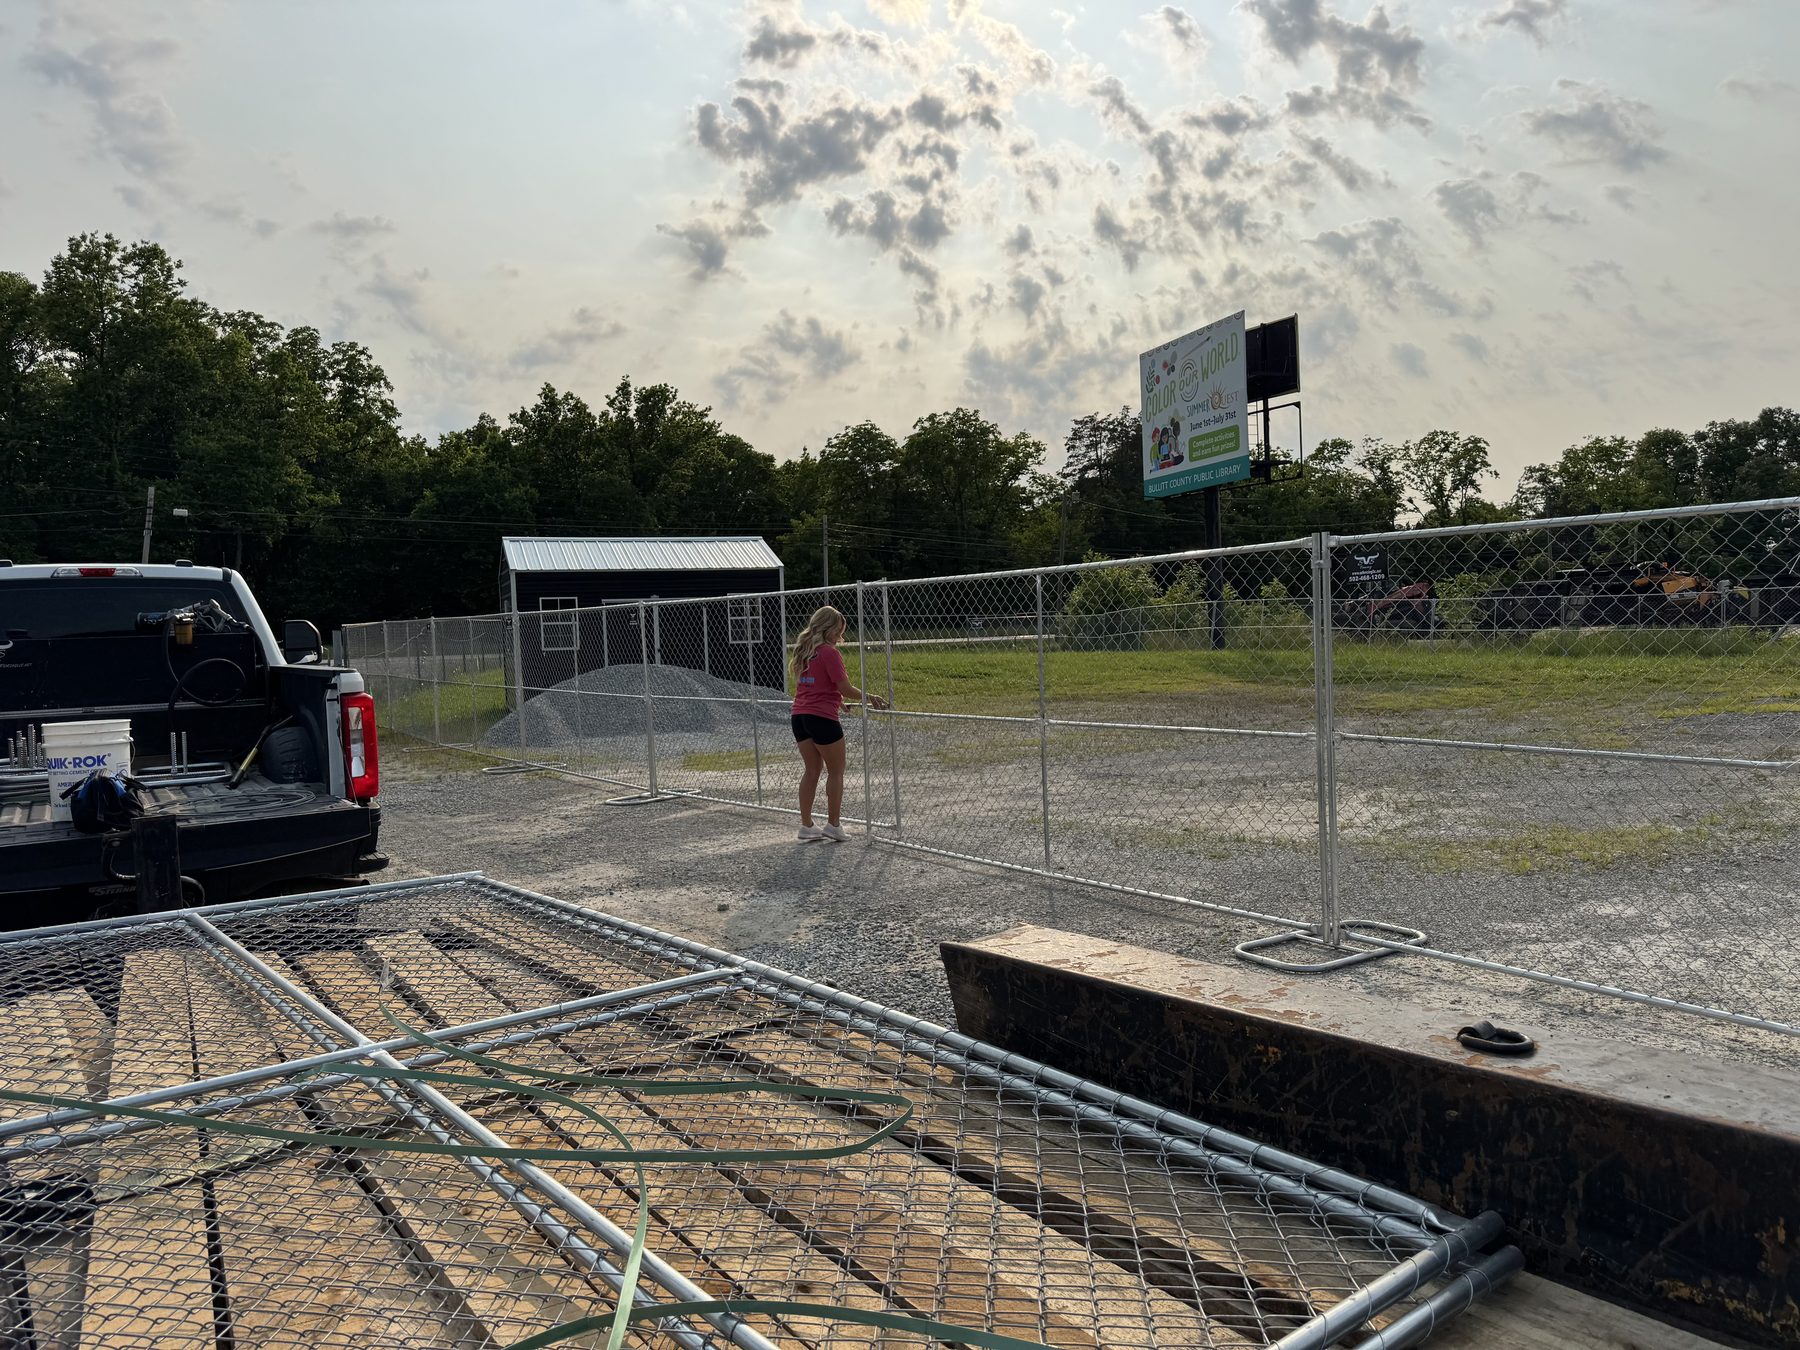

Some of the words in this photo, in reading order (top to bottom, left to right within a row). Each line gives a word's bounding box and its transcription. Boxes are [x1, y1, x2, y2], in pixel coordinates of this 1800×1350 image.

[1146, 380, 1176, 423] COLOR
[1179, 370, 1198, 391] OUR
[1200, 332, 1238, 382] WORLD
[1187, 399, 1209, 417] SUMMER
[1190, 421, 1202, 431] June
[1225, 411, 1236, 421] 31st
[1193, 436, 1213, 448] Complete
[1214, 432, 1235, 442] activities
[1192, 449, 1201, 457] and
[1212, 444, 1220, 452] fun
[1149, 481, 1168, 493] BULLITT
[1170, 476, 1192, 488] COUNTY
[1193, 470, 1214, 482] PUBLIC
[1215, 464, 1241, 478] LIBRARY
